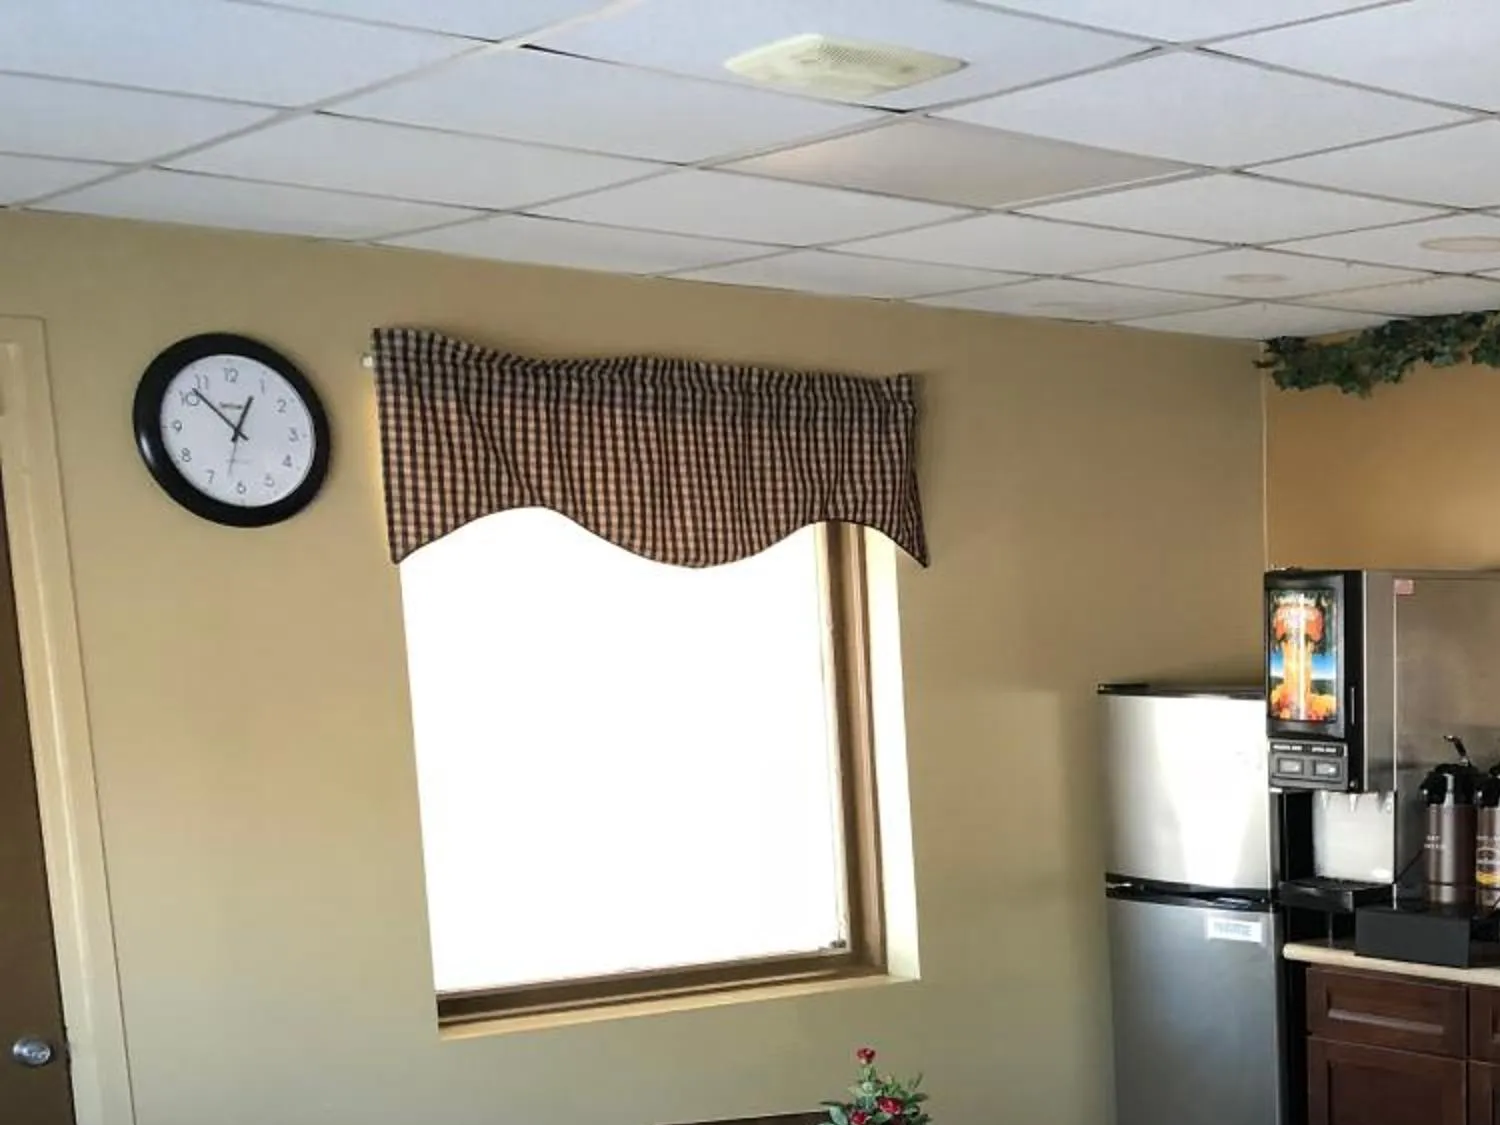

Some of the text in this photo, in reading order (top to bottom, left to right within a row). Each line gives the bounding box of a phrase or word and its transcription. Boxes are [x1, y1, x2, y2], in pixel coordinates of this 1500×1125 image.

[194, 373, 209, 390] 11
[223, 367, 239, 384] 12
[179, 391, 200, 407] 10
[275, 399, 288, 414] 2
[172, 419, 183, 433] 9
[288, 427, 300, 443] 3
[180, 447, 192, 463] 8
[281, 454, 293, 468] 4
[205, 469, 215, 484] 7
[236, 479, 247, 495] 6
